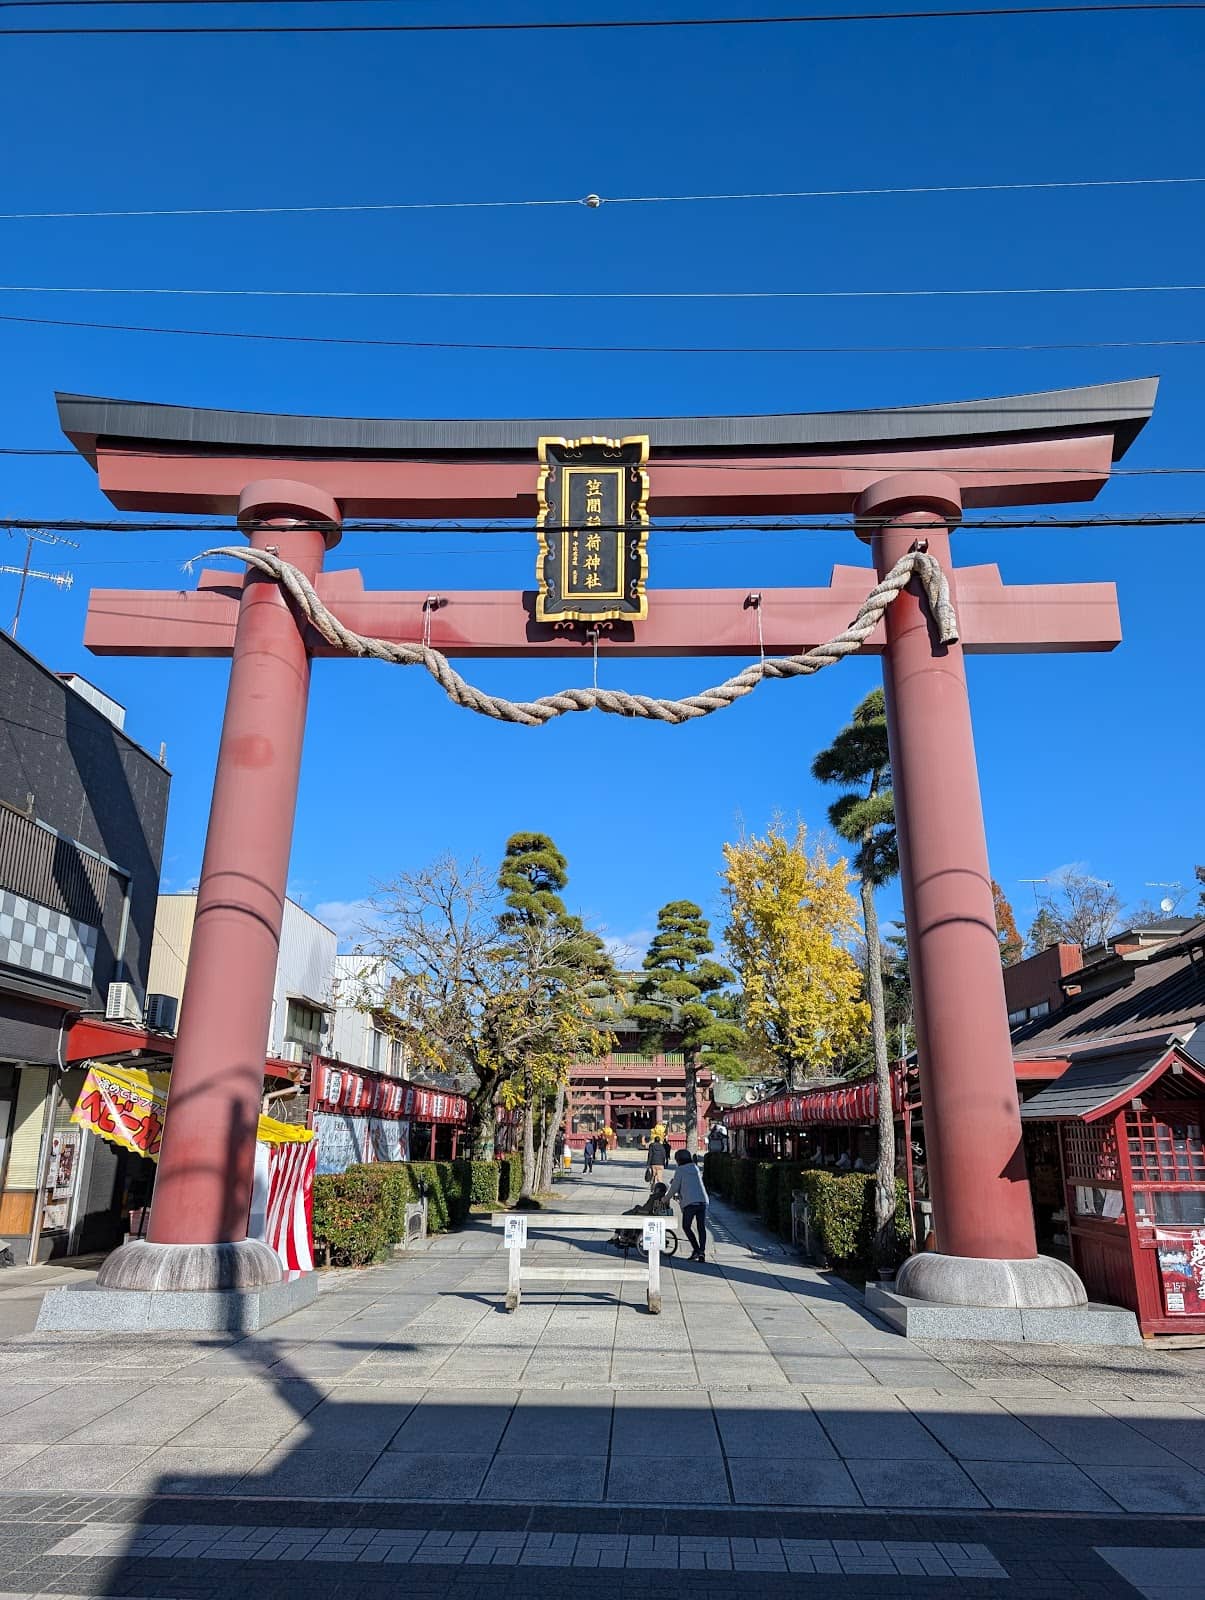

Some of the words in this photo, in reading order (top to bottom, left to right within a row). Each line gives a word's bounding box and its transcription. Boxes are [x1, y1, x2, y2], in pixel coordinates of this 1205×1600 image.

[99, 1077, 165, 1115] 冷めてもフワ
[81, 1090, 161, 1154] ベビーカ
